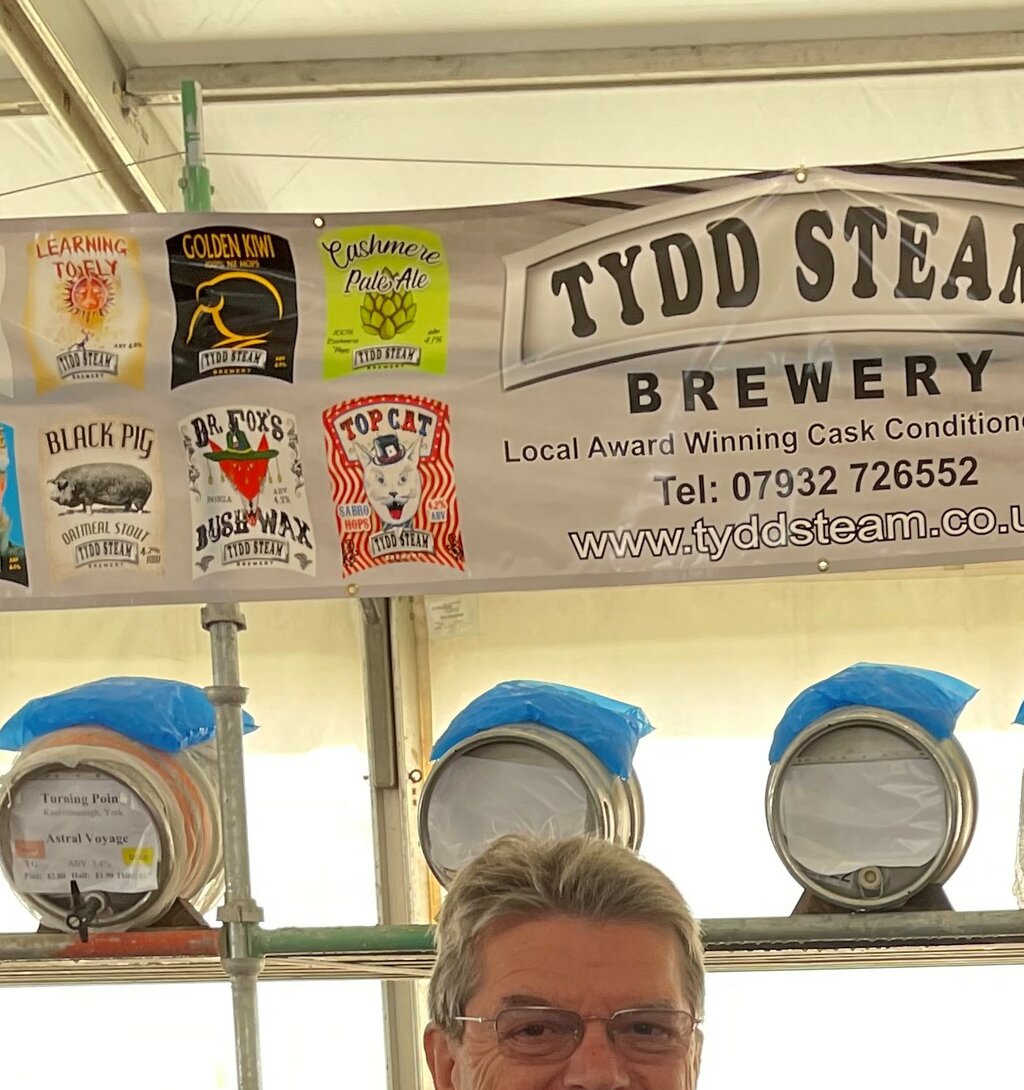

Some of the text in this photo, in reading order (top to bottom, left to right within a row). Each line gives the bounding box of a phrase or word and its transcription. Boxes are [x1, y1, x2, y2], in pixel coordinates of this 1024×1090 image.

[36, 236, 128, 259] LEARNING
[183, 233, 276, 259] GOLDEN KIWI
[321, 234, 442, 269] Cashmere
[54, 259, 118, 278] TO FLY
[345, 267, 428, 293] Pale Ale
[551, 217, 760, 338] TYDD
[59, 352, 112, 371] TYDD STEAM
[204, 351, 262, 367] TYDD STEAM
[358, 348, 416, 364] TYDD STEAM
[627, 349, 993, 414] BREWERY
[190, 411, 223, 448] DR.
[339, 407, 433, 441] TOP CAT
[45, 422, 113, 455] BLACK
[504, 437, 579, 463] Local
[588, 432, 676, 459] Award
[684, 427, 798, 459] Winning
[807, 420, 875, 447] Cask
[654, 456, 979, 506] Tel: 07932 726552
[339, 504, 369, 517] SABRO
[61, 521, 151, 545] OATMEAL STOUT
[257, 507, 313, 549] WAX
[345, 518, 369, 531] HOPS
[78, 542, 100, 560] TYDD
[103, 541, 133, 558] STEAM
[227, 541, 284, 559] TYDD STEAM
[374, 532, 429, 551] TYDD STEAM
[41, 793, 120, 806] Turning Poin
[47, 833, 129, 846] Astral Voyage
